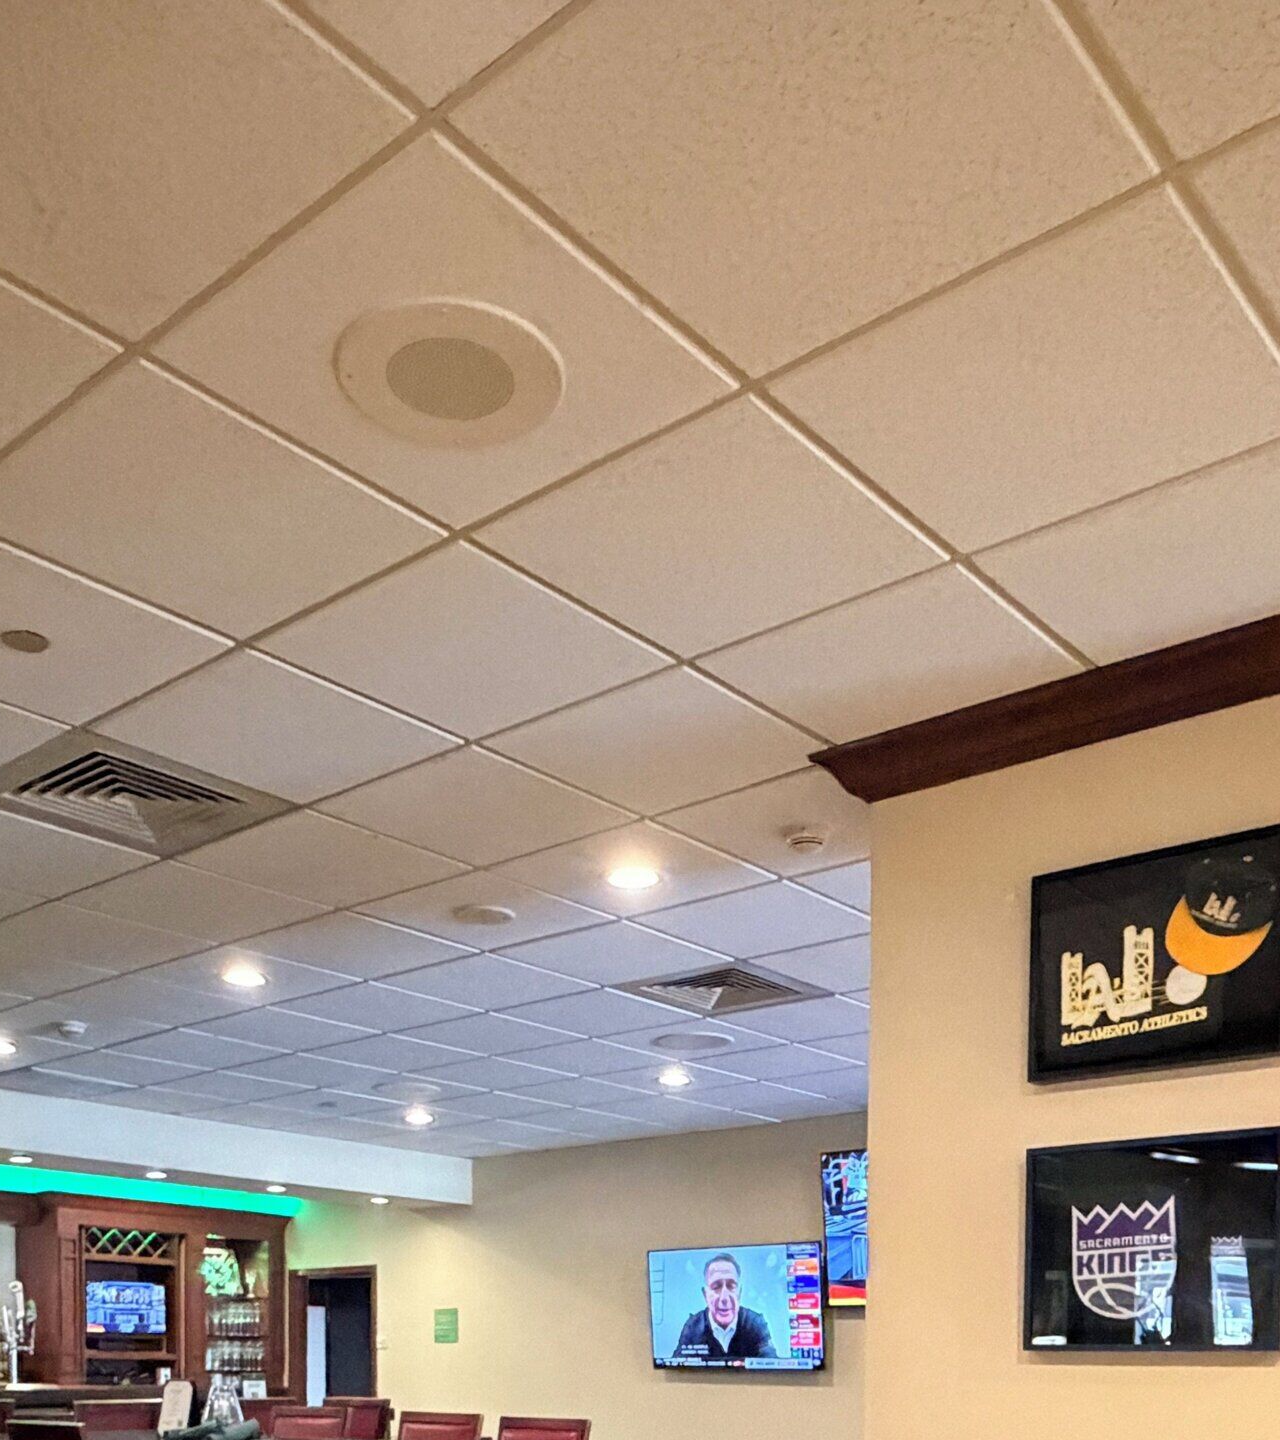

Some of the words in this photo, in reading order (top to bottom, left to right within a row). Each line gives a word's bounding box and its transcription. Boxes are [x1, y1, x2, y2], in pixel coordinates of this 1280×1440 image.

[1060, 1021, 1139, 1046] SACRAMENTO
[1140, 1006, 1208, 1032] ATHLETICS
[1079, 1233, 1169, 1249] SACRAMENTO
